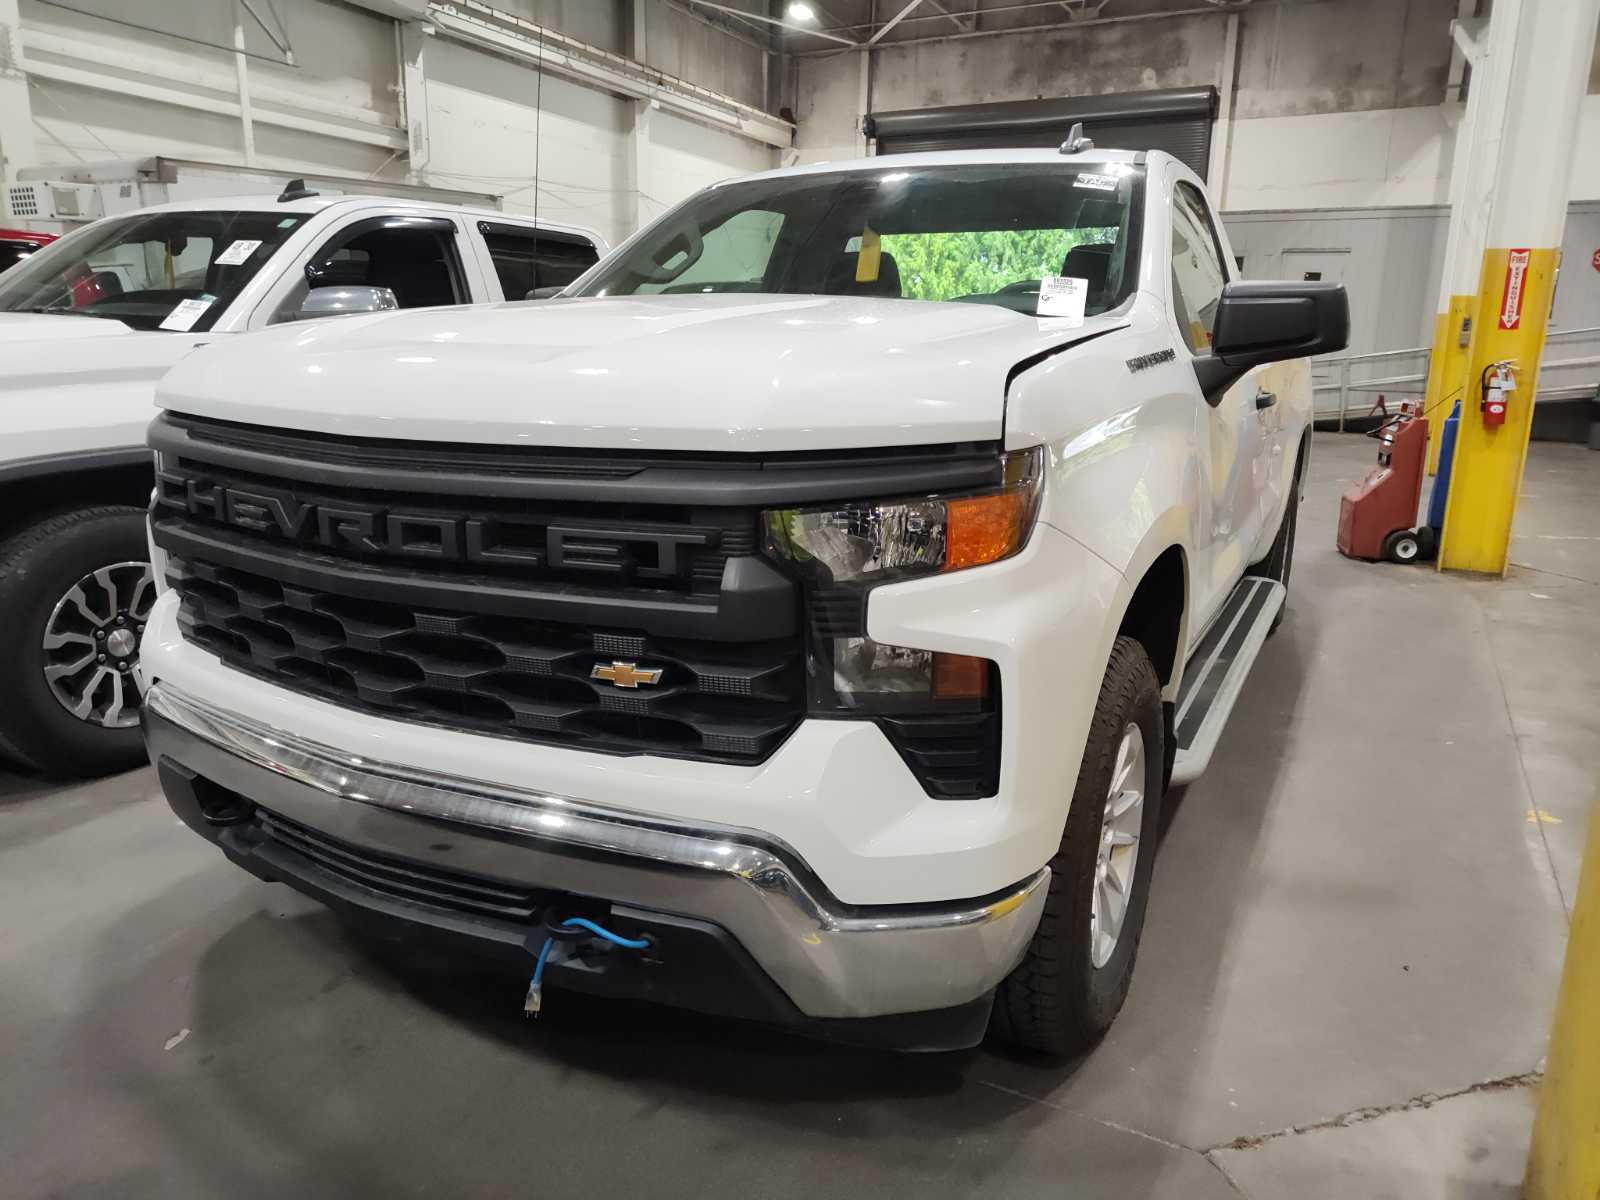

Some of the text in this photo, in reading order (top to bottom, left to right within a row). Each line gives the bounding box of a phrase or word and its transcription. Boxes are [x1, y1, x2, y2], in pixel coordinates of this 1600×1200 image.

[1511, 255, 1528, 264] FIRE
[1506, 266, 1520, 324] EXTINGUISHER
[157, 470, 721, 576] CHEVROLET
